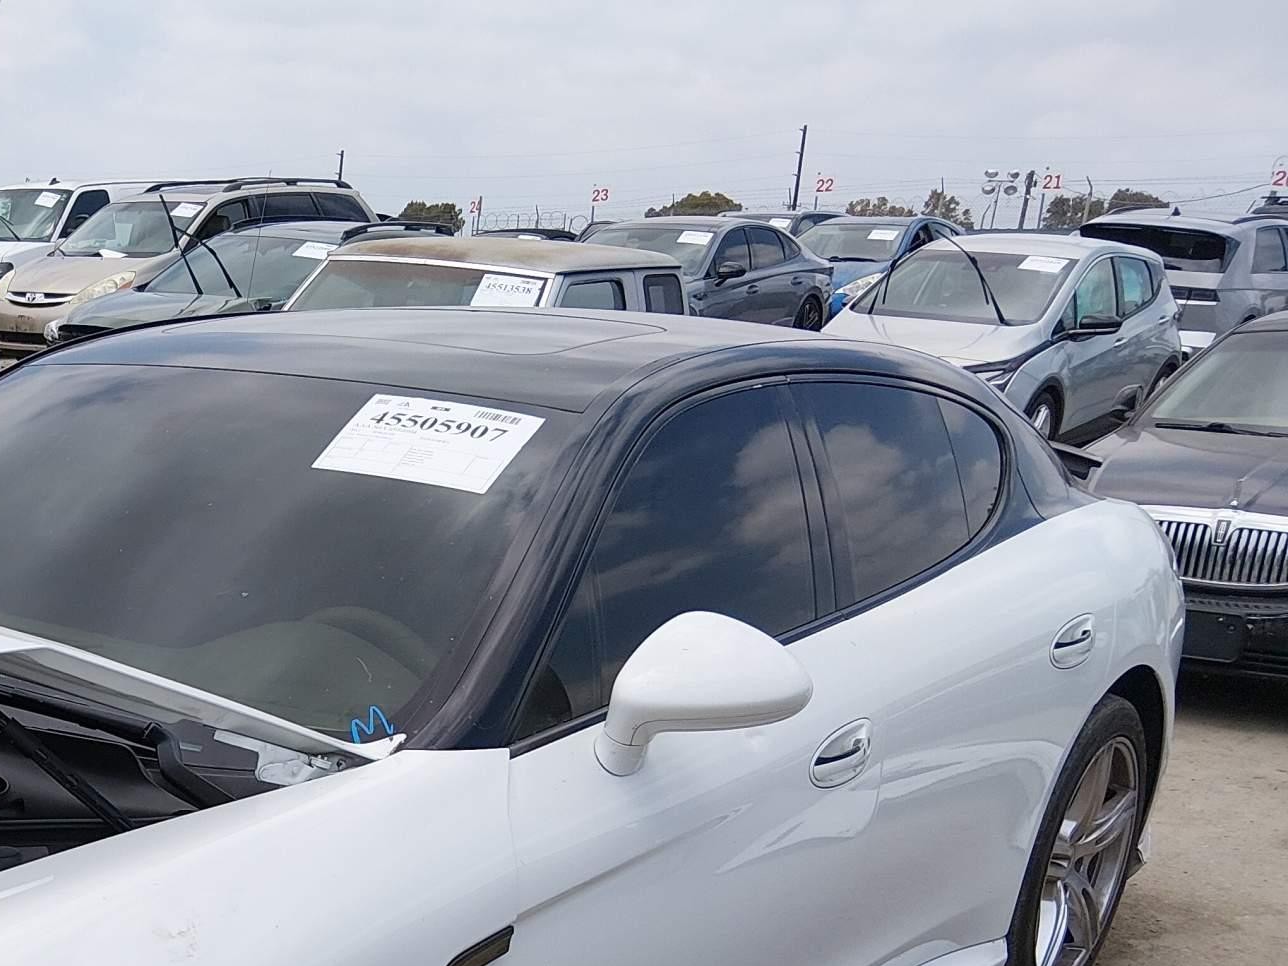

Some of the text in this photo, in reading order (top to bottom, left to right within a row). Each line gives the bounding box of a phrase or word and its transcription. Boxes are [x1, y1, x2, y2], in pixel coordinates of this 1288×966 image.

[816, 178, 834, 192] 22
[1042, 174, 1061, 189] 21
[1272, 170, 1288, 187] 2
[592, 189, 609, 202] 23
[370, 411, 509, 442] 45505907
